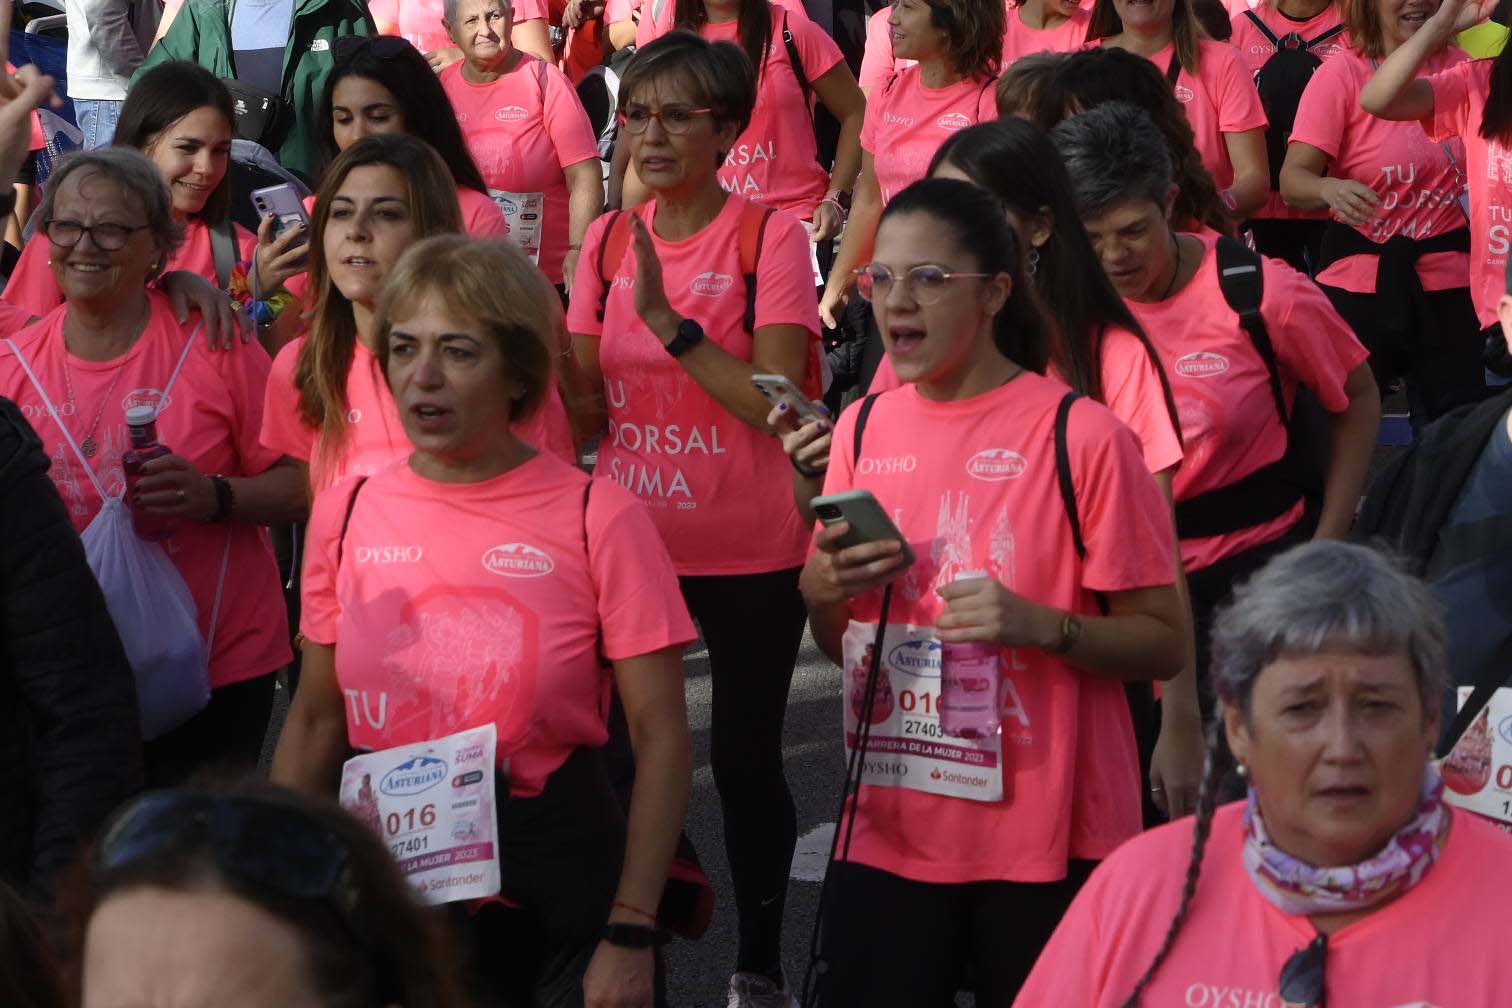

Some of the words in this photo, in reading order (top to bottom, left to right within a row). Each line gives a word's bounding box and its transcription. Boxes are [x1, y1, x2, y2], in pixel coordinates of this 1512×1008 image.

[1381, 162, 1416, 184] TU
[1489, 205, 1512, 222] TU
[609, 380, 626, 409] U
[859, 455, 917, 475] OYSHO
[611, 459, 693, 499] SUMA
[355, 545, 423, 565] OYSHO
[487, 552, 551, 573] ASTURIANA
[344, 687, 388, 731] TU
[385, 768, 446, 794] ASTURIANA
[942, 769, 988, 788] Santander
[385, 803, 437, 836] 016
[430, 875, 484, 892] Santander
